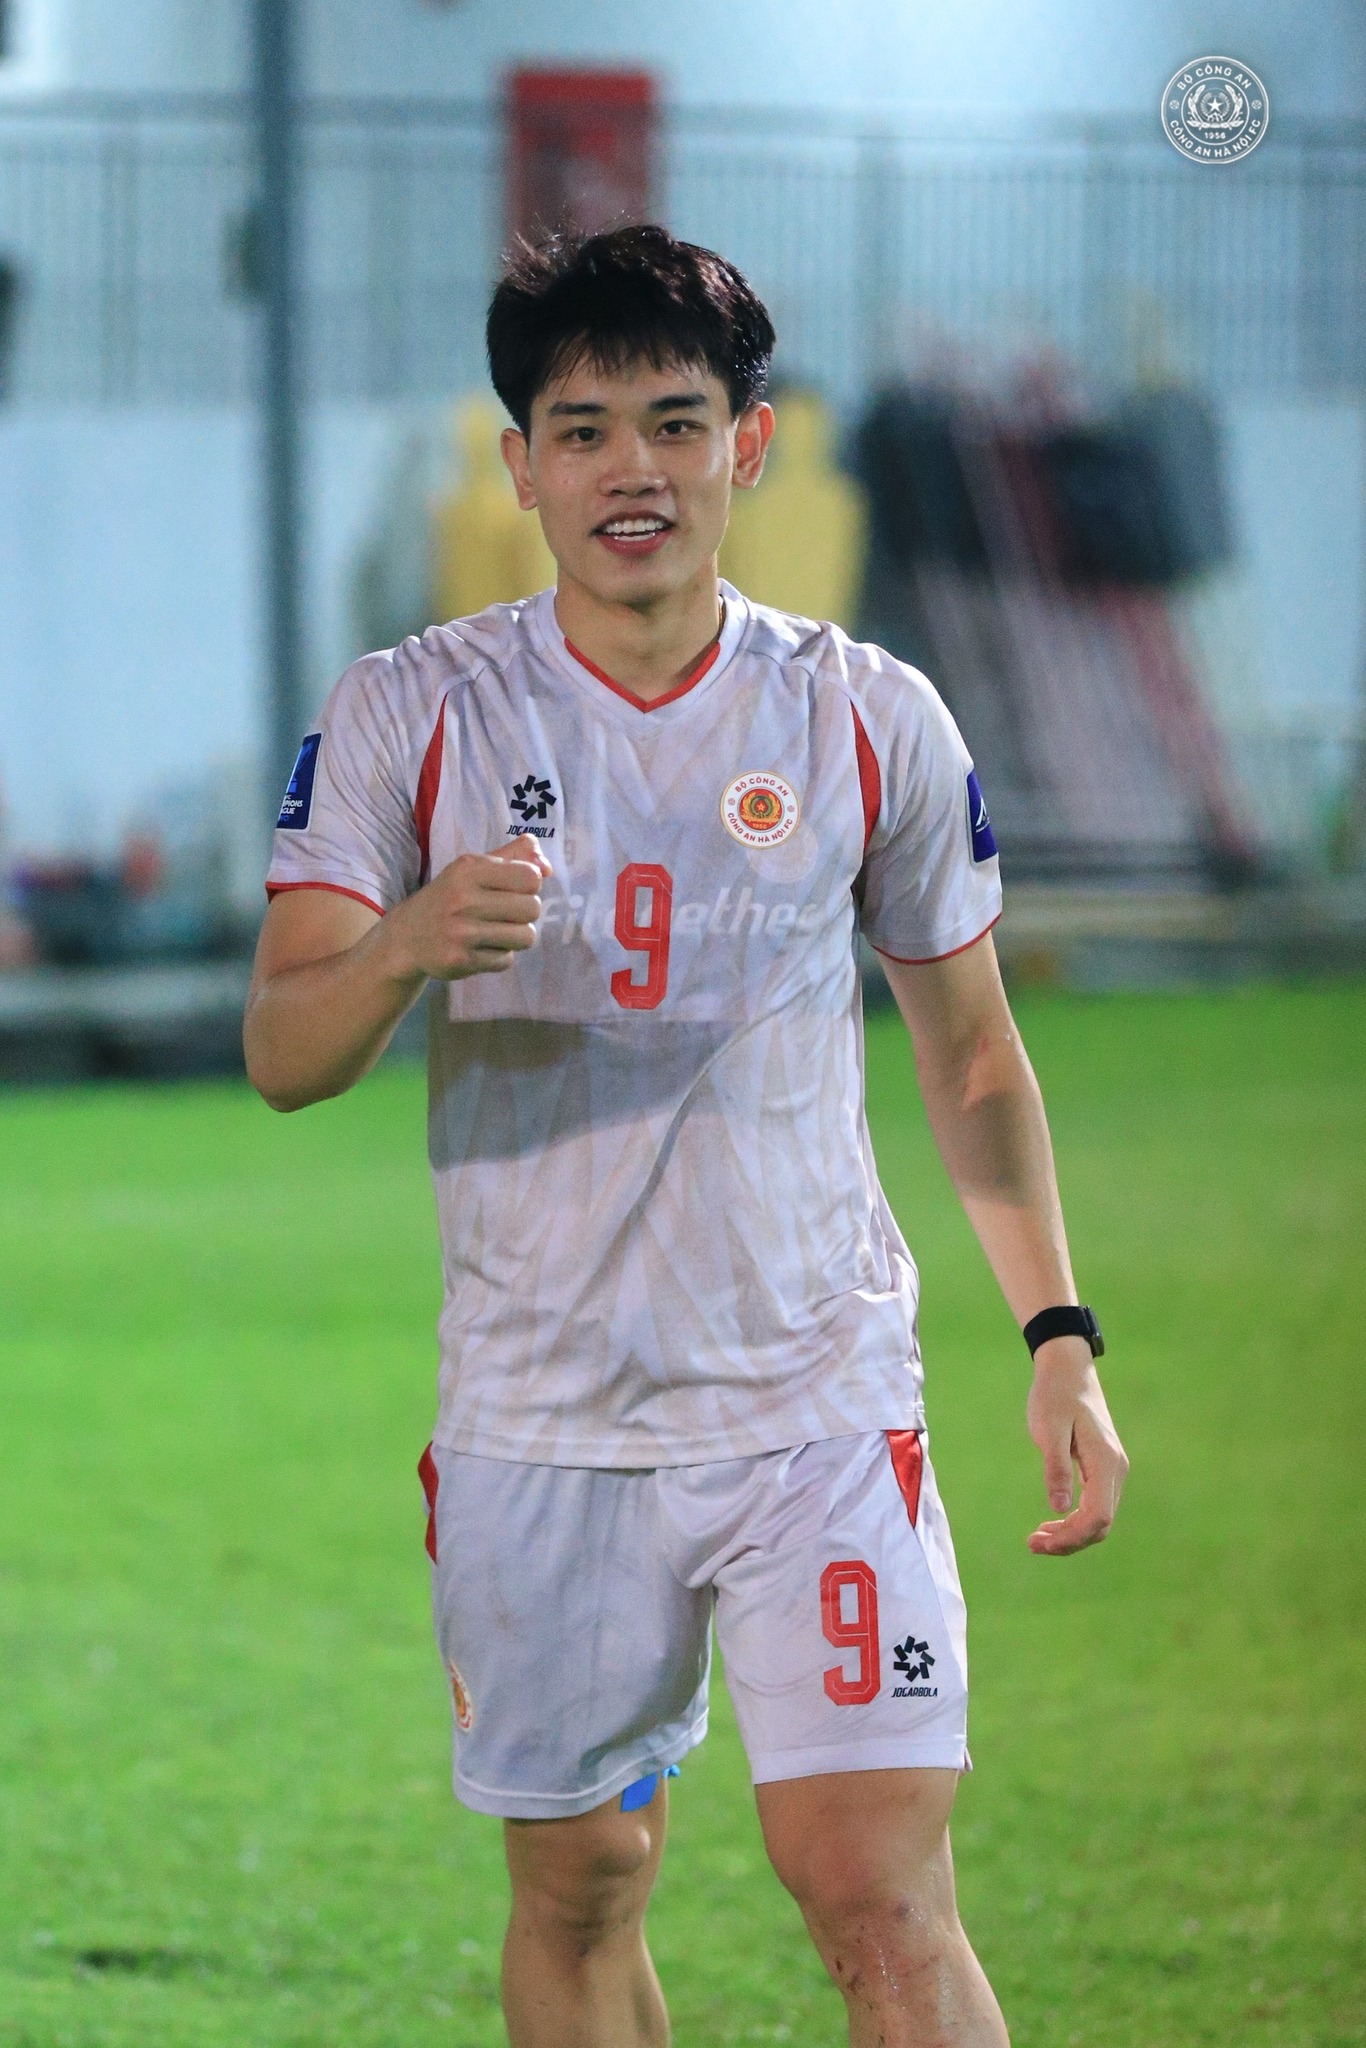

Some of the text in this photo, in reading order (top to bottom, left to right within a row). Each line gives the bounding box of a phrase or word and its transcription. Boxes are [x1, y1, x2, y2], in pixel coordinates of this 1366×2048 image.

[735, 776, 789, 796] BỘ CÔNG AN
[728, 812, 744, 834] CÔNG
[744, 832, 755, 841] AN
[771, 828, 786, 840] NỘI
[784, 819, 793, 829] FC
[611, 863, 673, 1010] 9
[819, 1560, 881, 1706] 9
[891, 1687, 938, 1698] JOGARBOLA
